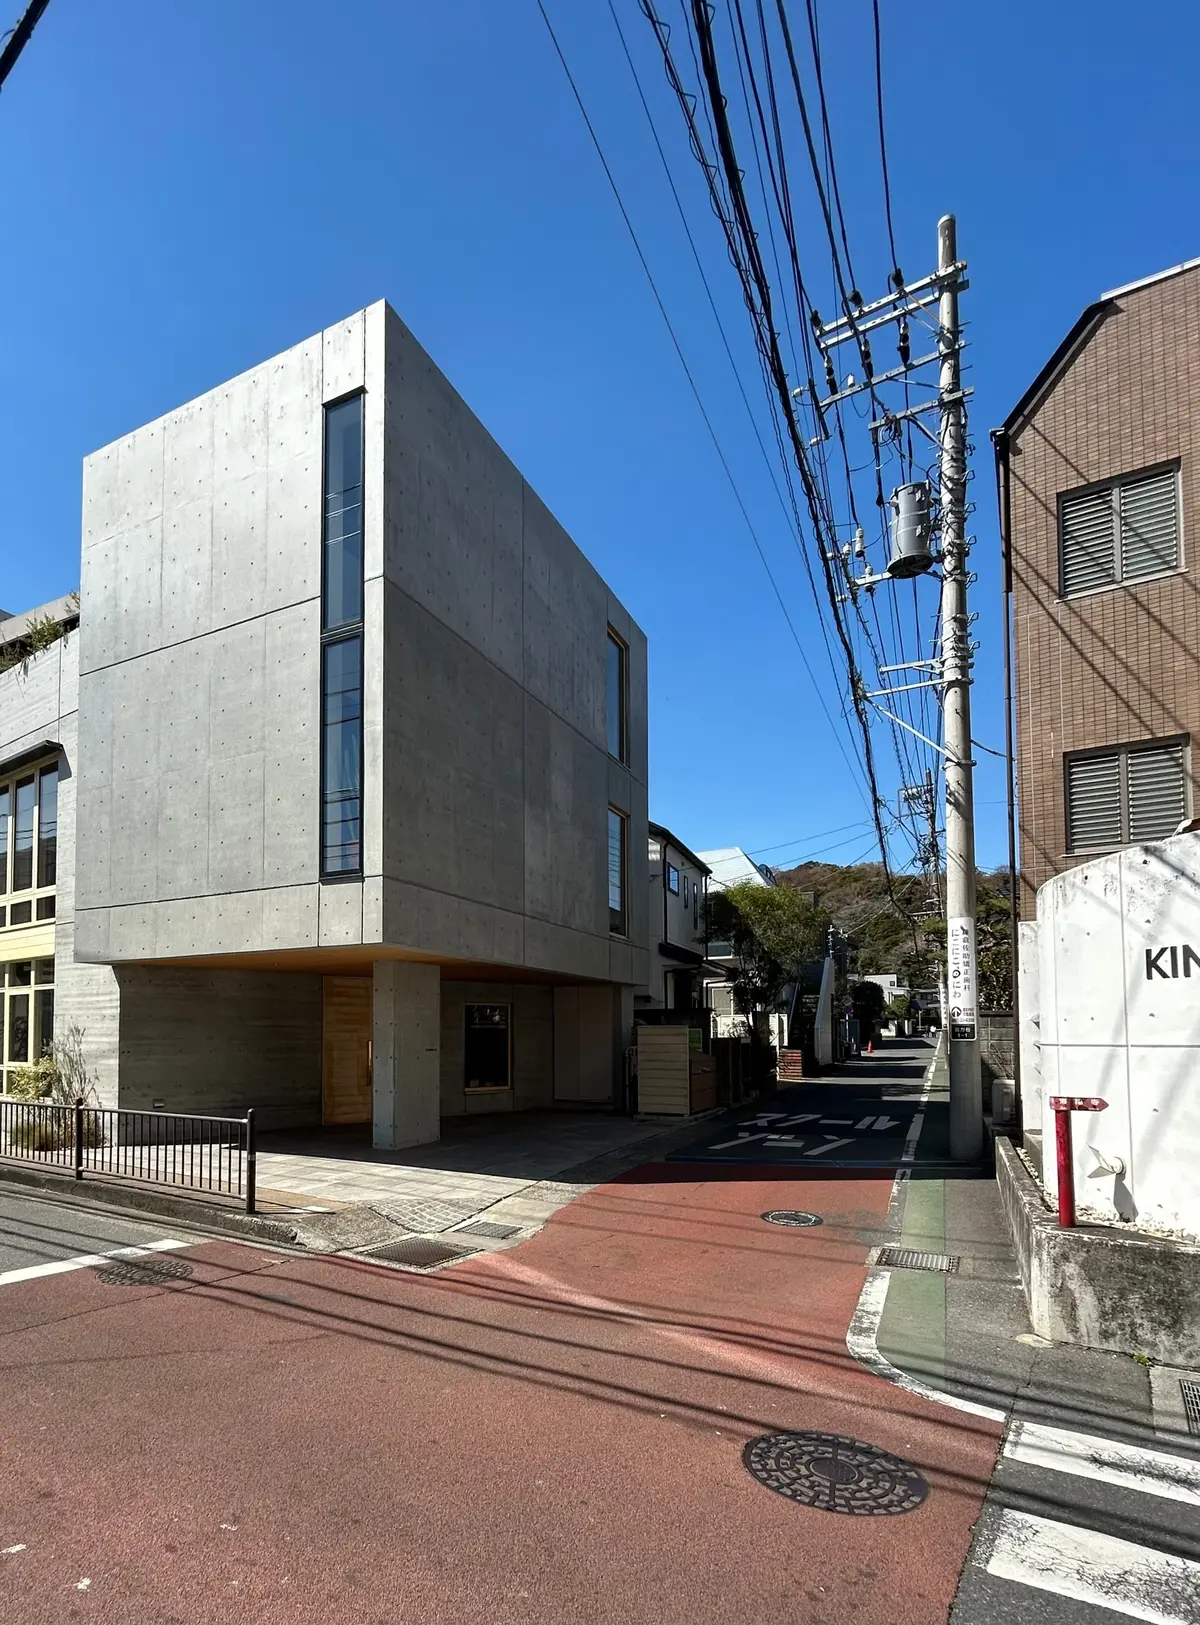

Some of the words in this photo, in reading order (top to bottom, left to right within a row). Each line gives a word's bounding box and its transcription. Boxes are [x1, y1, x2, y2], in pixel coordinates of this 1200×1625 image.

[737, 1113, 901, 1130] スクール
[708, 1132, 857, 1156] ゾーン
